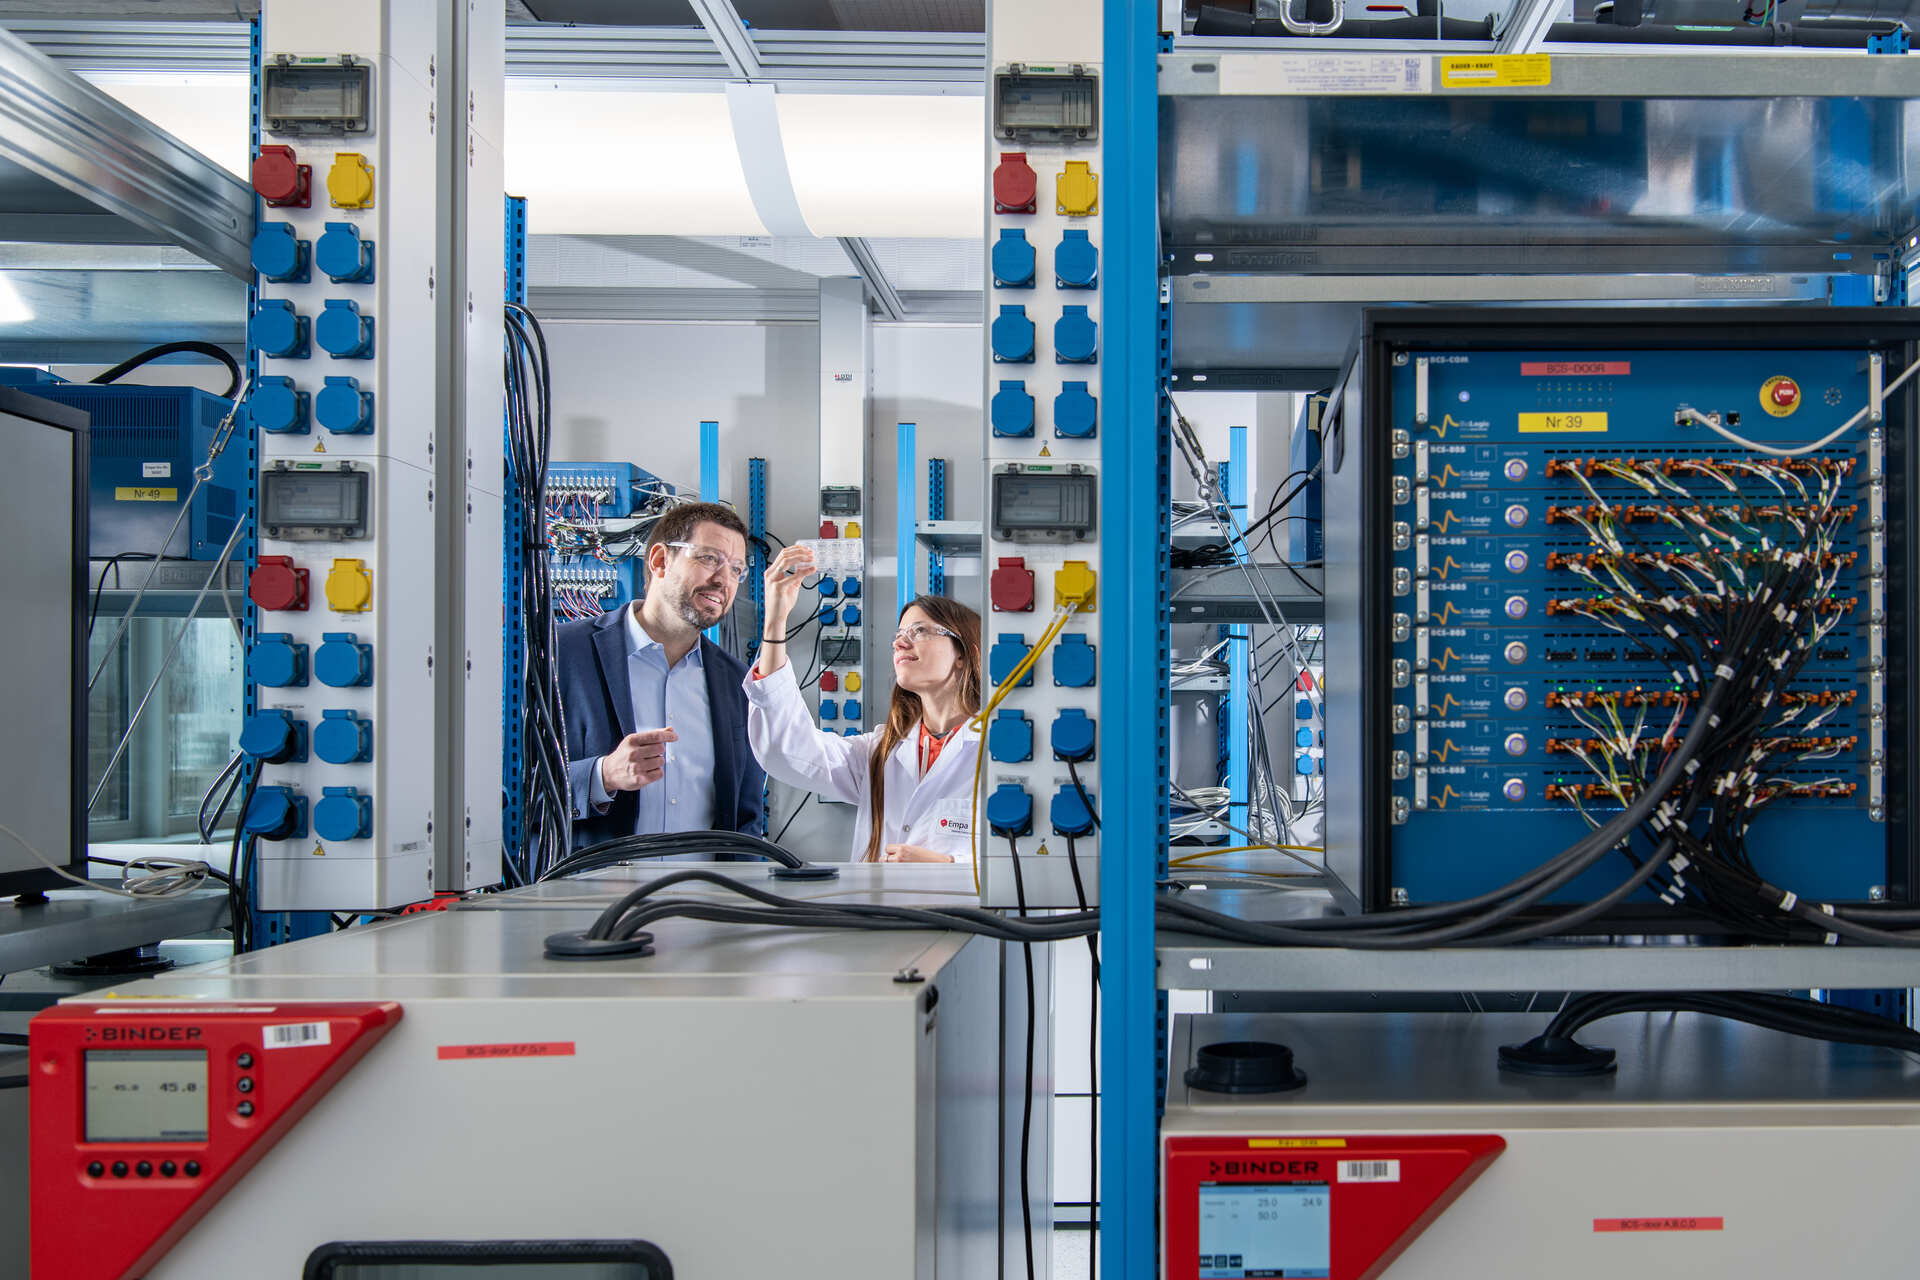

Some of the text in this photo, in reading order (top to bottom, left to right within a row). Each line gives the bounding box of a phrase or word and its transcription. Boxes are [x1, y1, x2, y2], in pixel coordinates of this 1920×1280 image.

[1546, 362, 1606, 375] BCS-DOOR
[1545, 415, 1583, 429] Nr 39
[134, 489, 145, 499] Nr
[948, 820, 969, 830] Empa
[101, 1027, 203, 1041] BINDER
[159, 1082, 198, 1093] 45.0
[1225, 1161, 1319, 1175] BINDER
